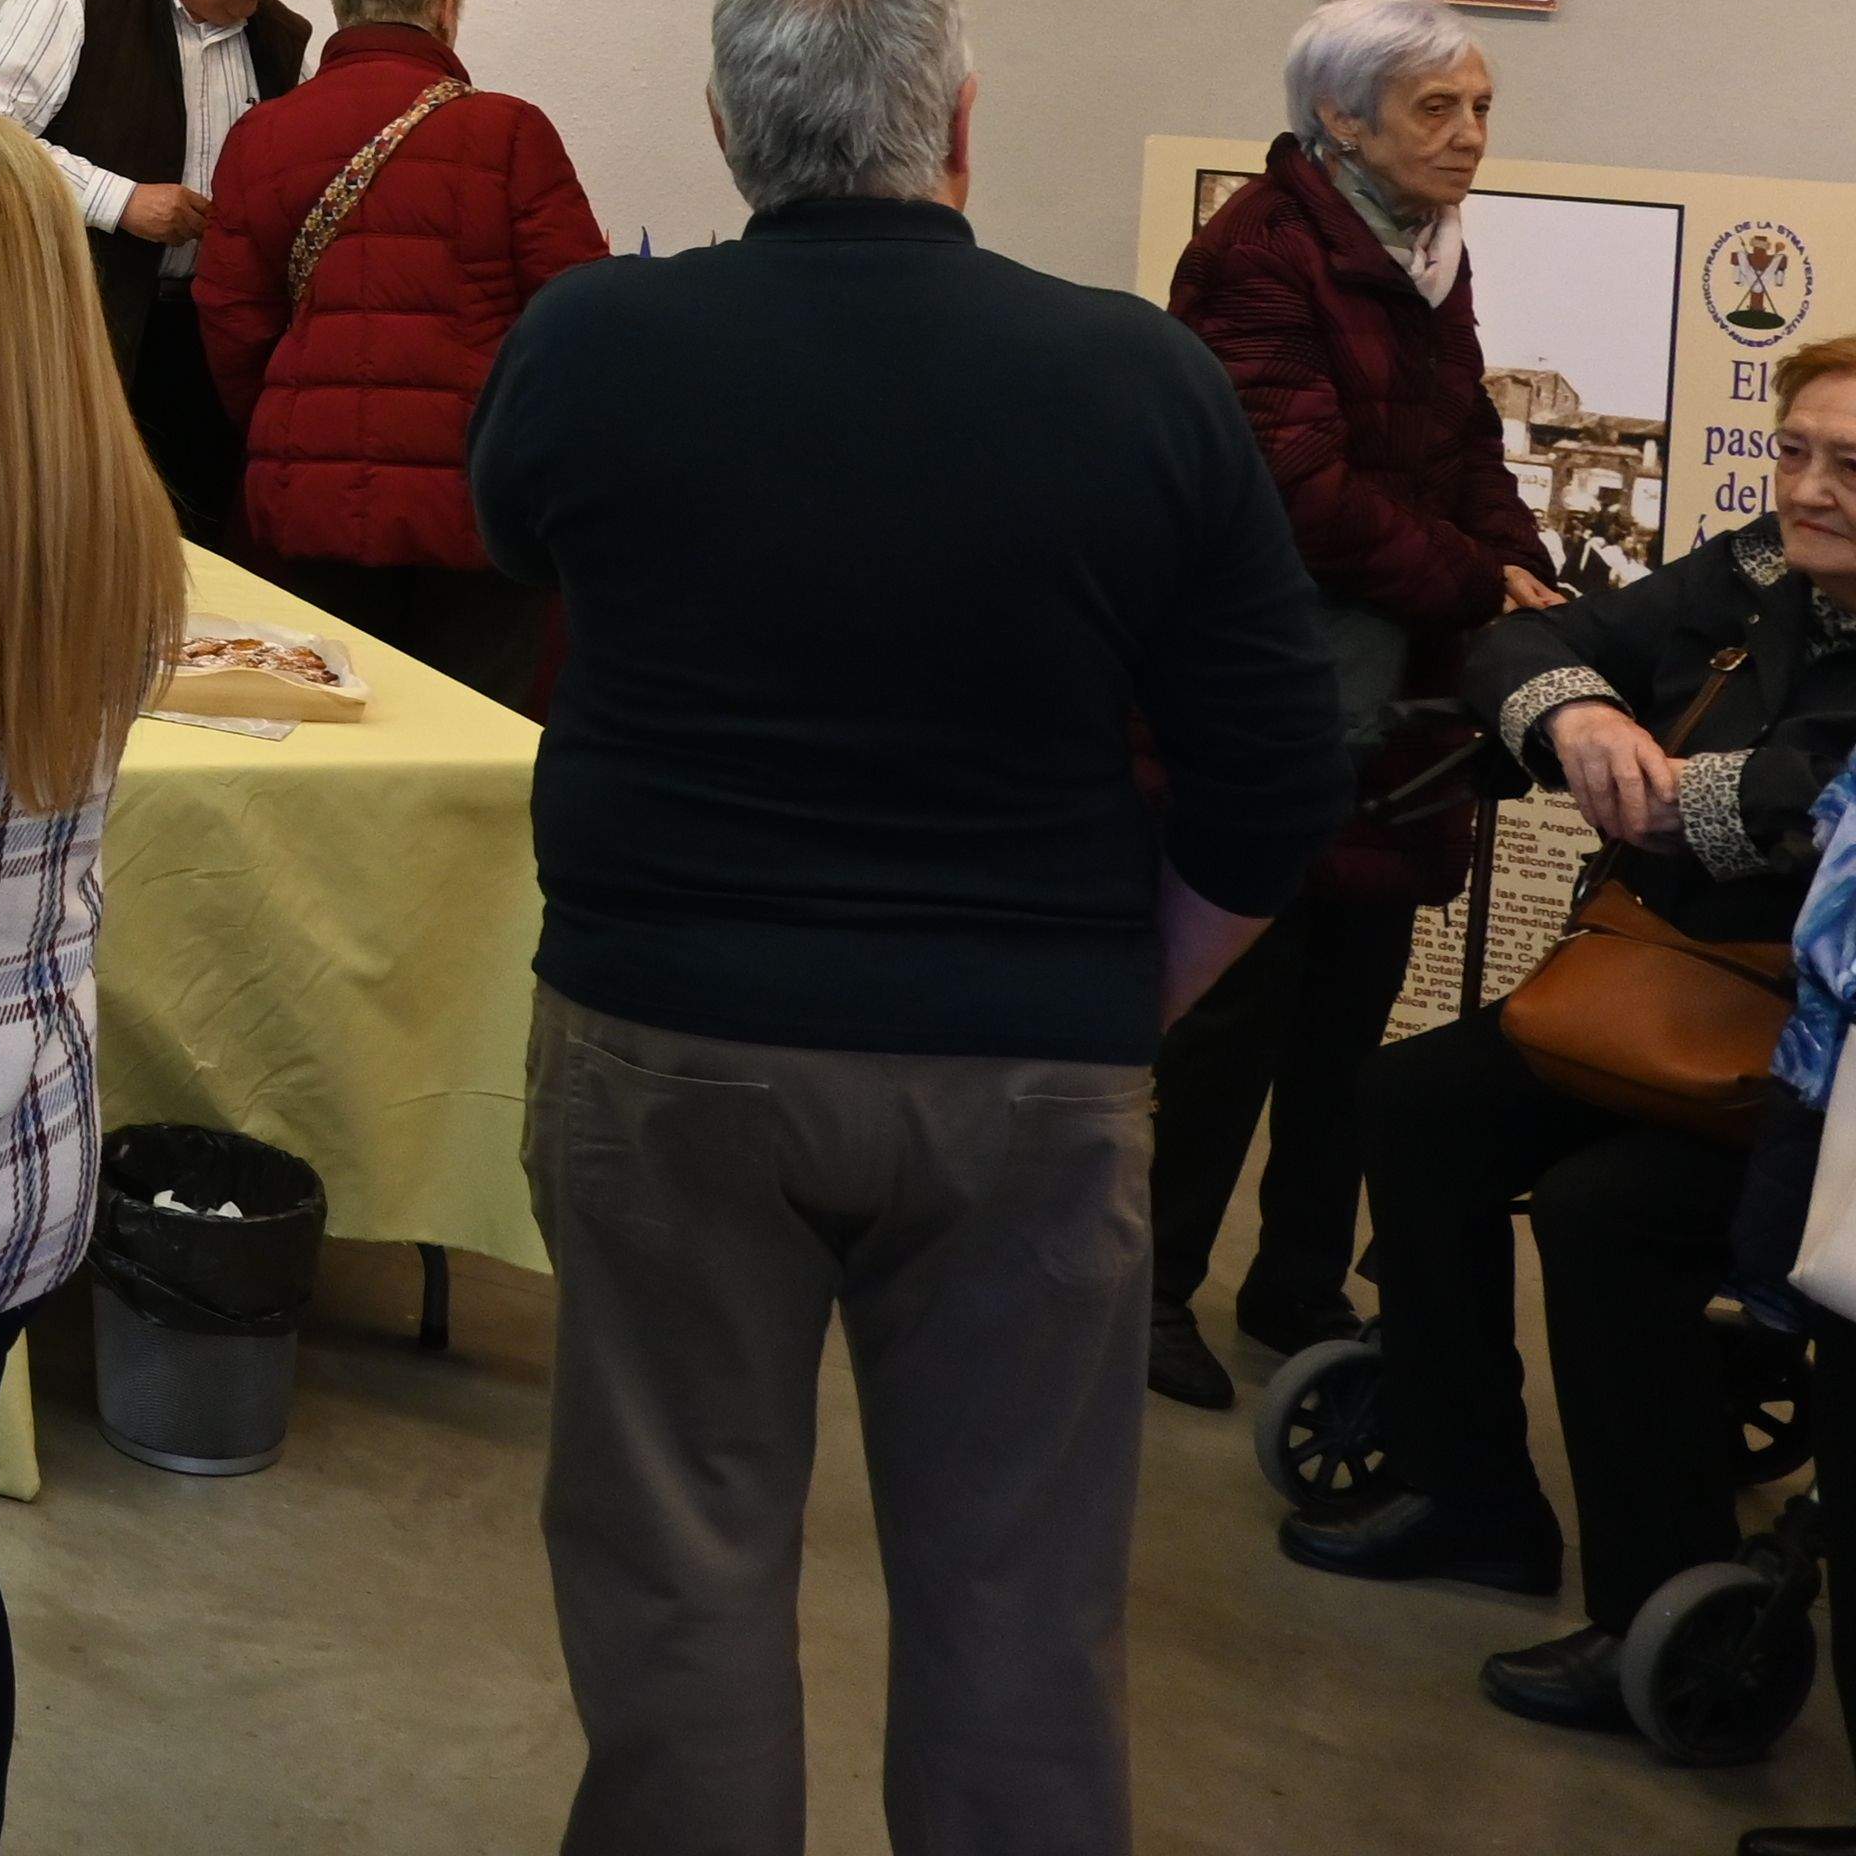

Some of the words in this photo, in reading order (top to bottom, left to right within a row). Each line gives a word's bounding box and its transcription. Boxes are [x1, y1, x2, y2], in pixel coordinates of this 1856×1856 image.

[1734, 221, 1751, 233] DE
[1756, 221, 1773, 229] LA
[1730, 359, 1769, 403] El
[1715, 471, 1769, 516] del
[1498, 814, 1531, 829] Bajo
[1547, 847, 1566, 858] de
[1508, 854, 1574, 872] balcones
[1519, 869, 1547, 881] que
[1496, 887, 1517, 900] las
[1521, 894, 1565, 907] cosas
[1505, 902, 1528, 914] fue
[1533, 906, 1569, 920] impo
[1437, 927, 1449, 939] la
[1515, 941, 1533, 952] no
[1438, 940, 1456, 952] de
[1412, 972, 1425, 984] la
[1497, 974, 1515, 986] de
[1414, 987, 1452, 1000] parte
